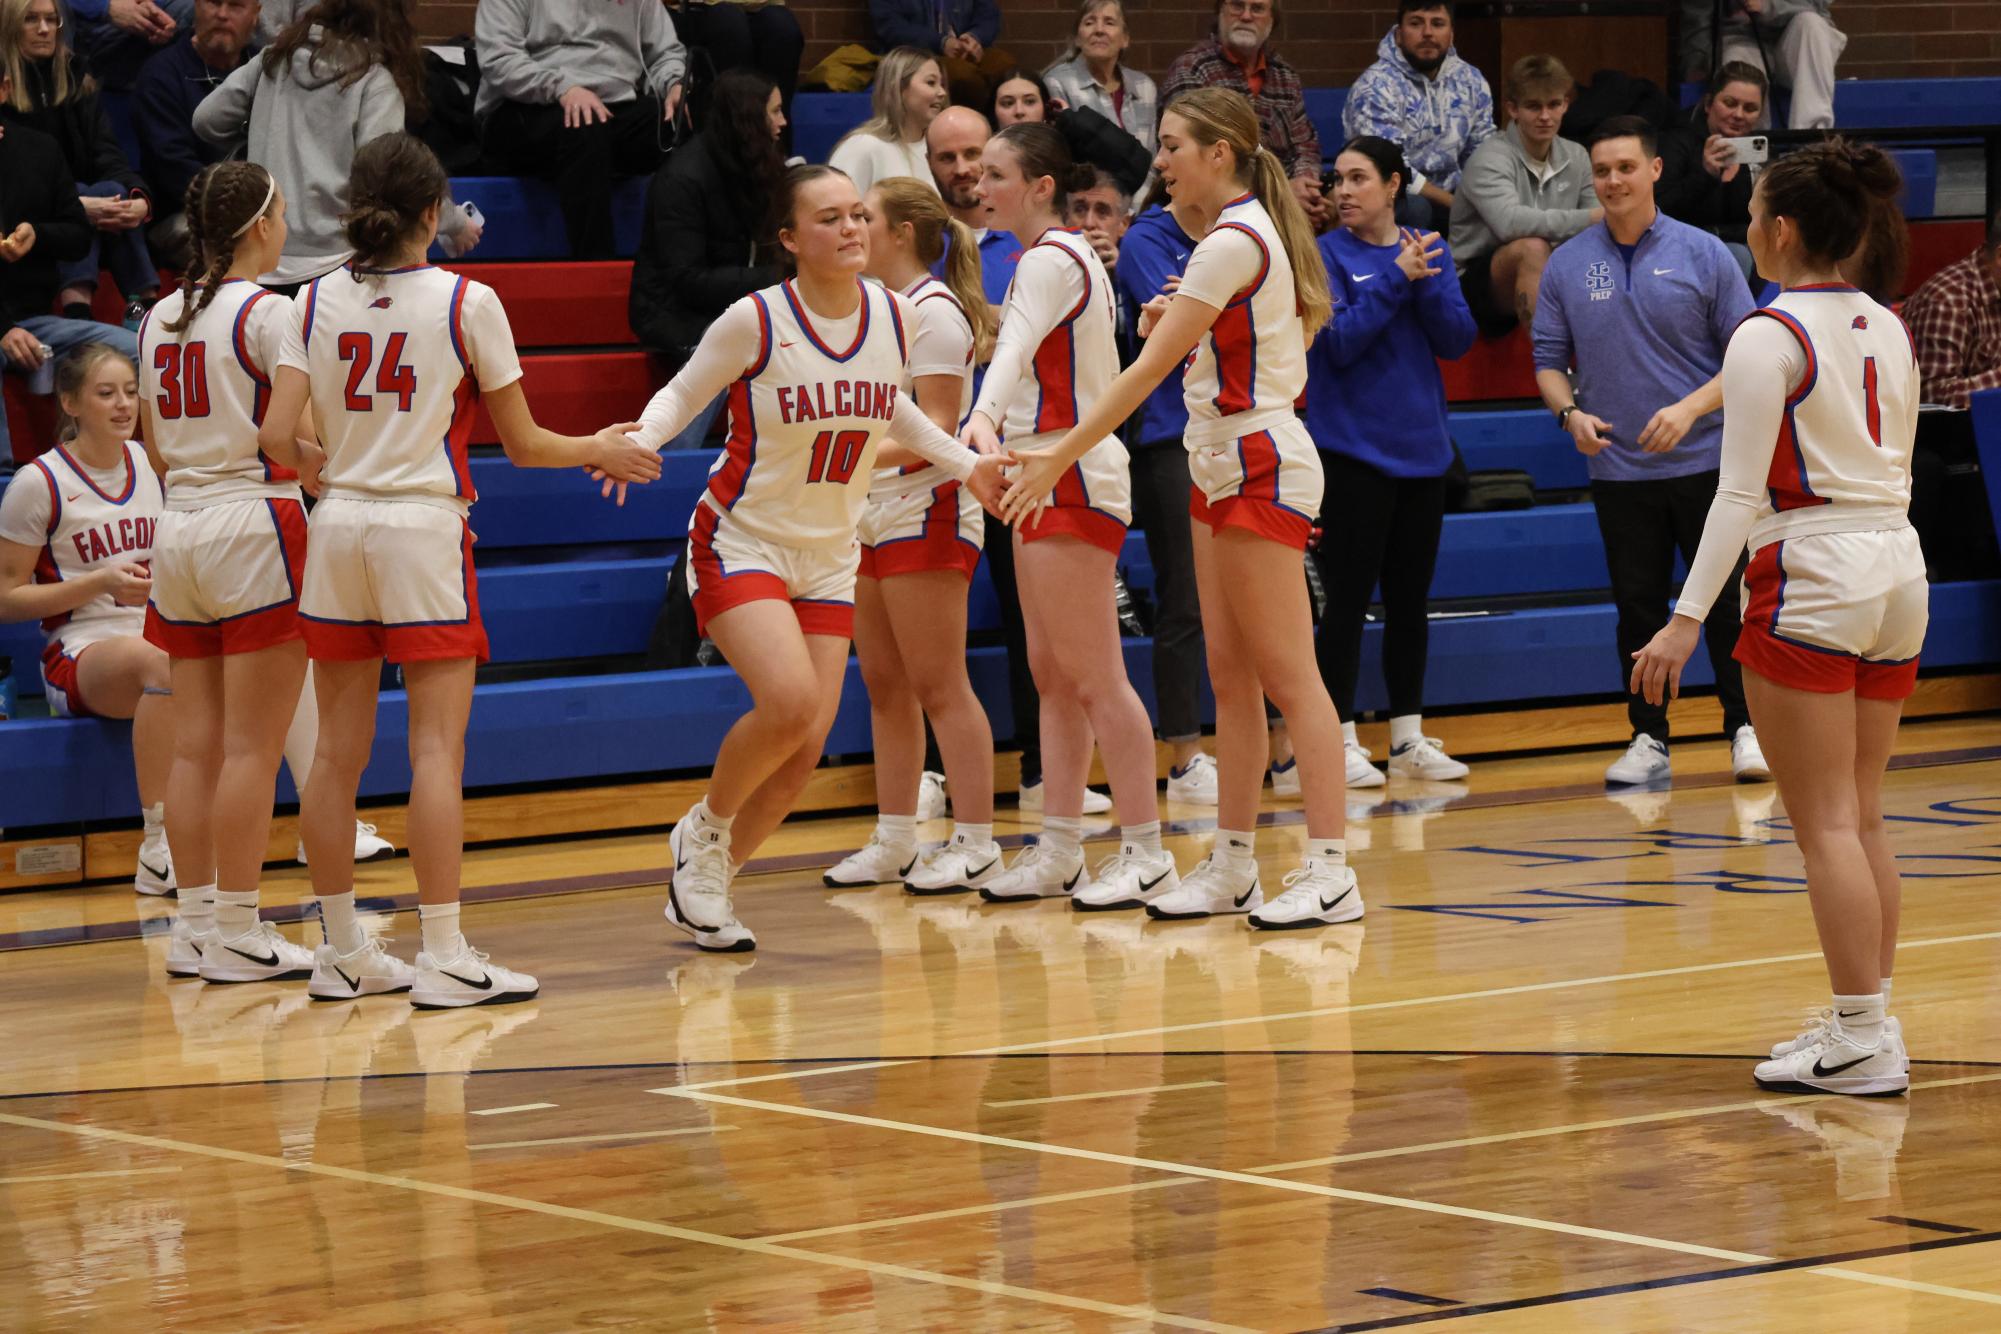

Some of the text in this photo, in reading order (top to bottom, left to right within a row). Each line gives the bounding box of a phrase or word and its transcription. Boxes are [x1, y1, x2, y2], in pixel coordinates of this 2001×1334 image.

[1590, 291, 1612, 301] PREP
[154, 340, 211, 419] 30
[337, 331, 417, 412] 24
[776, 380, 897, 424] FALCONS
[1863, 356, 1881, 447] 1
[806, 430, 870, 484] 10
